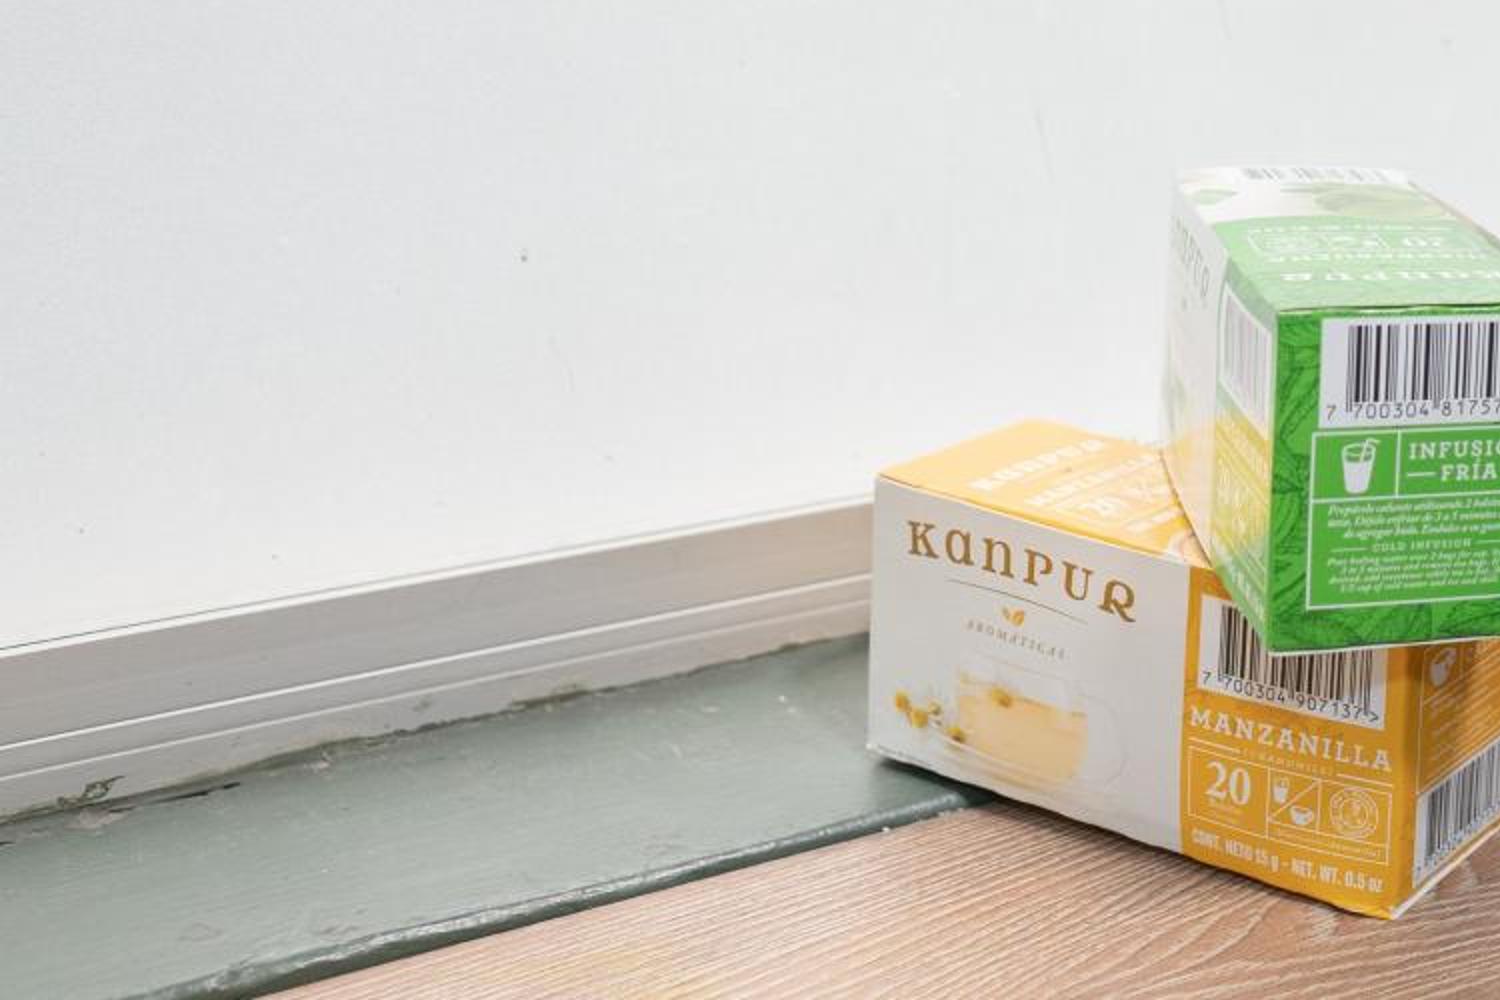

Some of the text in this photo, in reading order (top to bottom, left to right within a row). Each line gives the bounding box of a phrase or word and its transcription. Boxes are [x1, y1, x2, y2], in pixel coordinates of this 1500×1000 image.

[1327, 405, 1337, 421] 7
[1353, 401, 1430, 419] 700304
[1441, 458, 1498, 482] FRÍA
[1203, 671, 1212, 685] 7
[1225, 676, 1285, 704] 700304
[1190, 705, 1392, 772] MANZANILLA
[1205, 760, 1250, 806] 20
